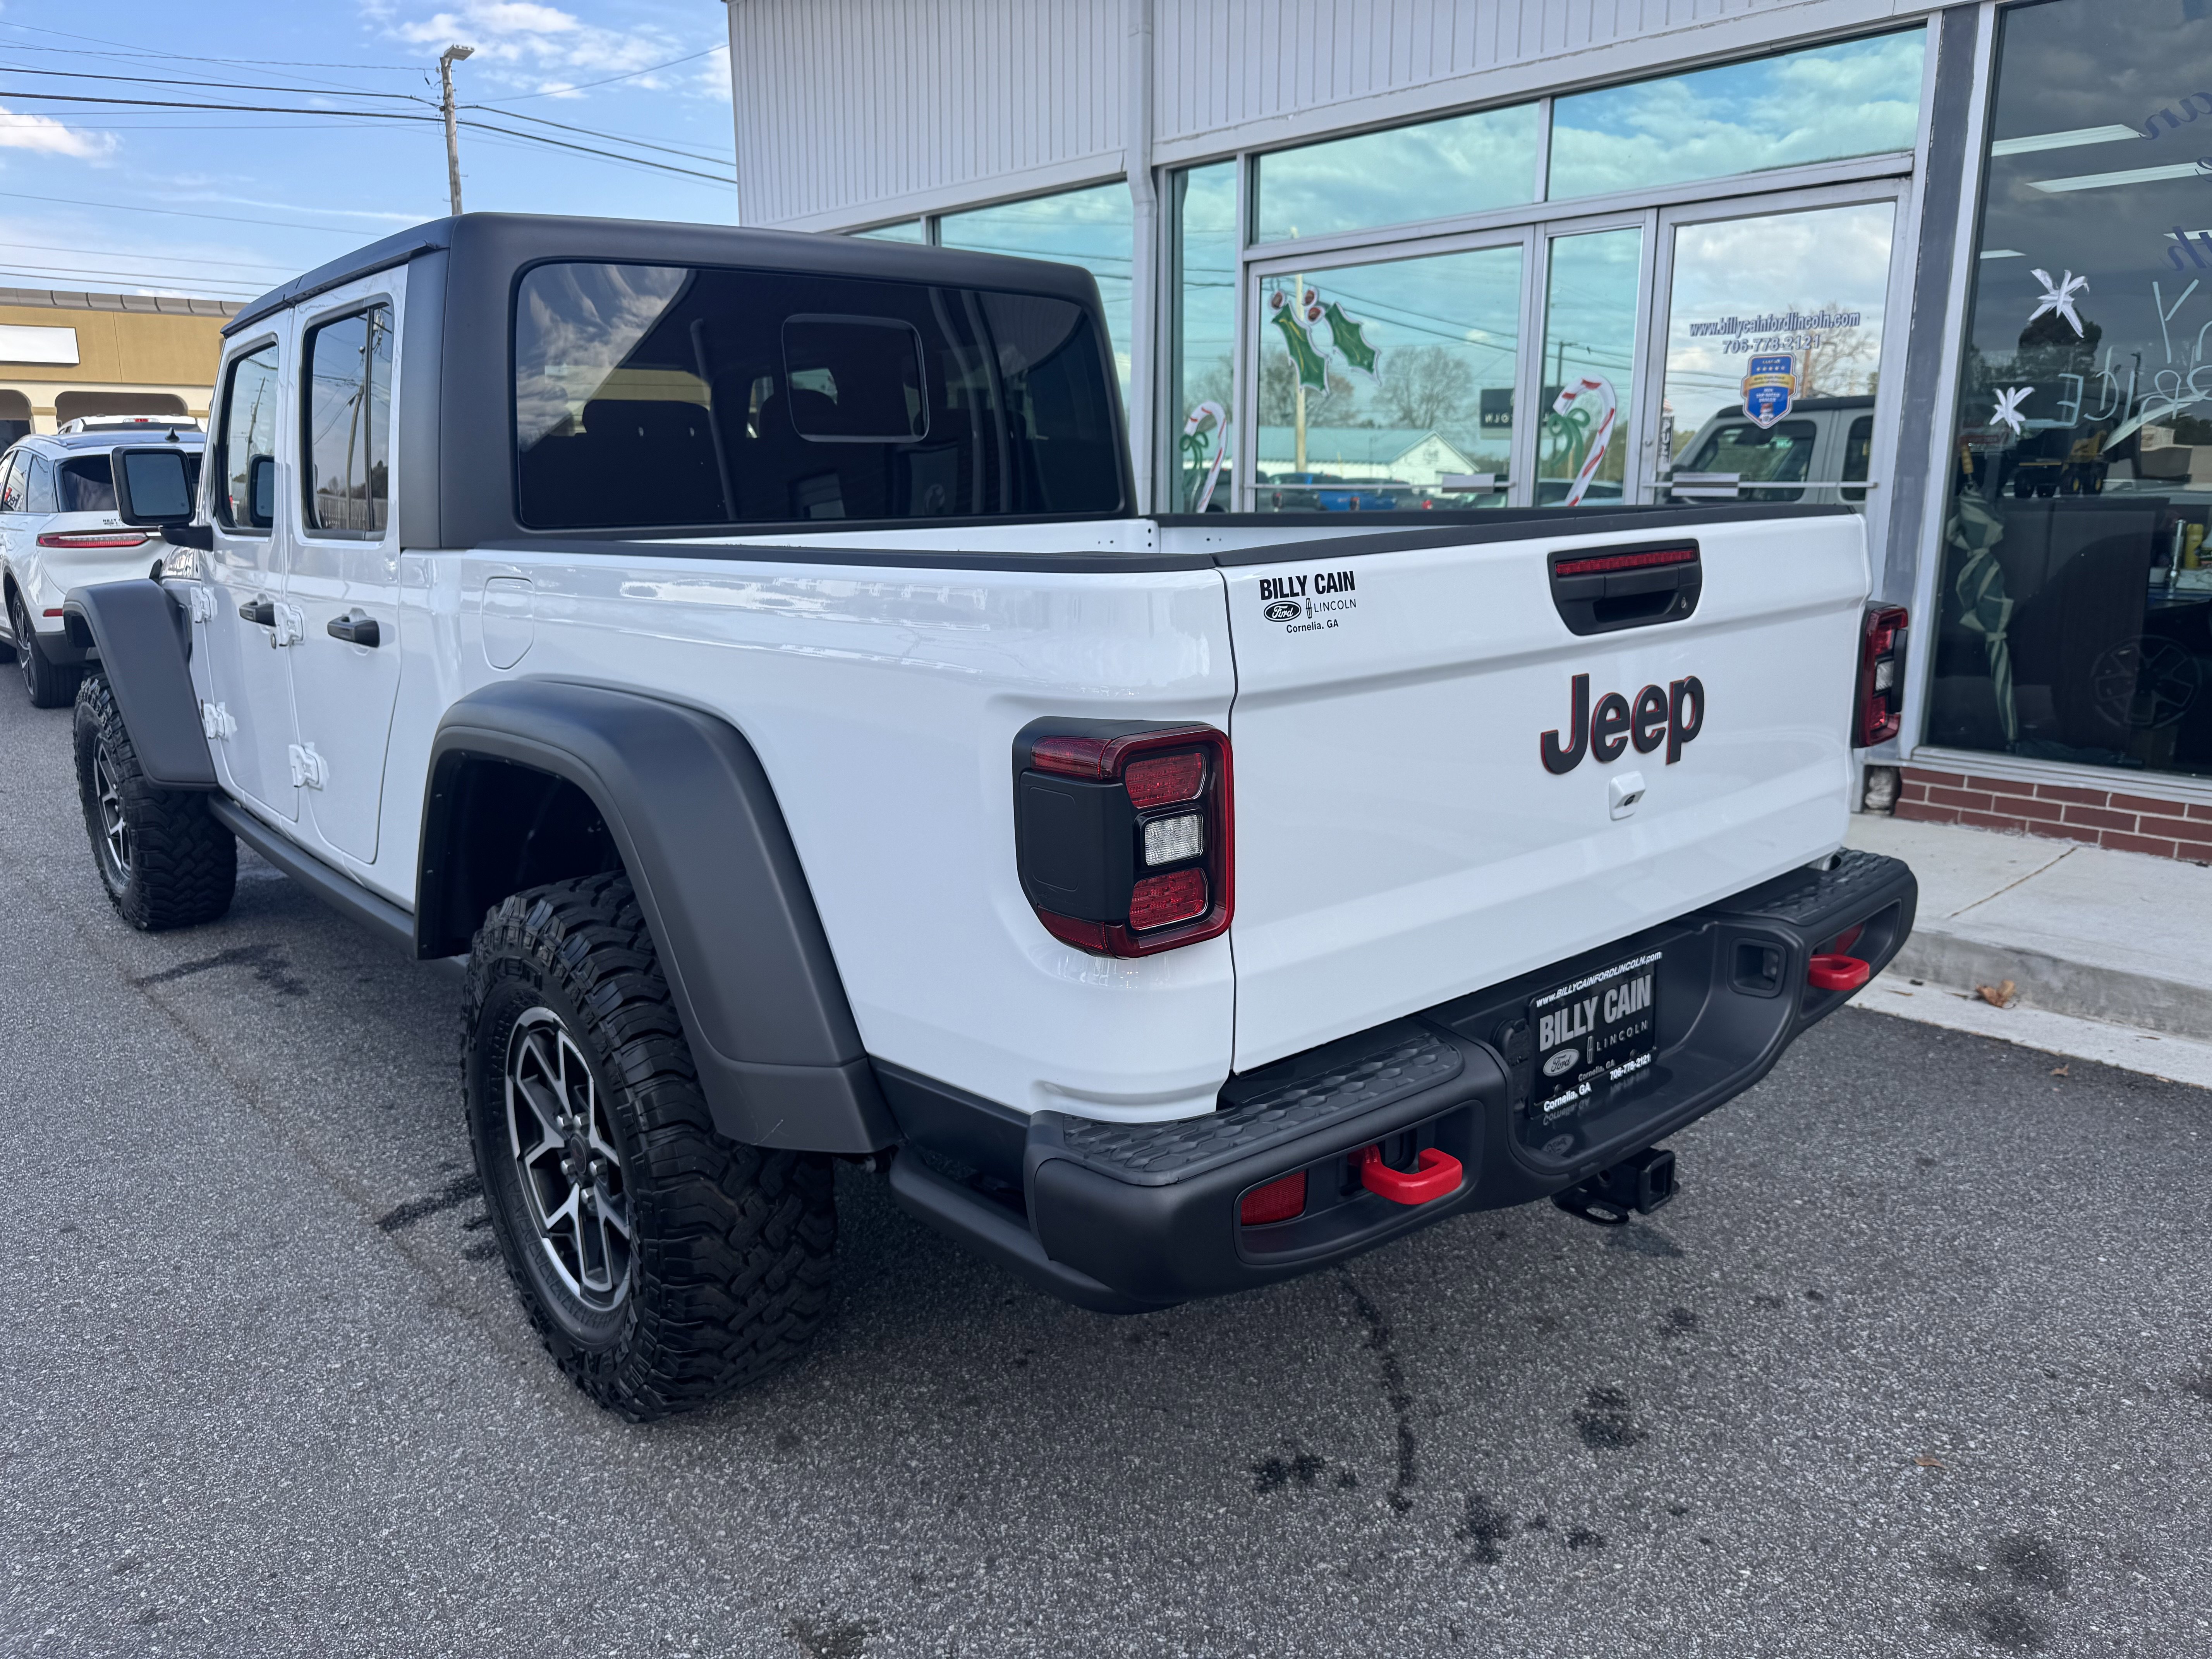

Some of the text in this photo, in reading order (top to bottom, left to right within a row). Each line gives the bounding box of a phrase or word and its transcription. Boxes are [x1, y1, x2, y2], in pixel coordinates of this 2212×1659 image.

[1689, 310, 1860, 338] www.billycainfordlincoln.com
[1722, 335, 1820, 354] 706-778-2121
[1259, 571, 1355, 600] BILLY CAIN
[1314, 599, 1356, 612] LINCOLN
[1327, 619, 1339, 628] GA
[1540, 673, 1704, 775] Jeep
[1536, 951, 1662, 1008] www.BILLYCAINFORDLINCOLN.com
[1540, 974, 1651, 1052] BILLY CAIN
[1596, 1020, 1649, 1051] LINCOLN
[1606, 1059, 1615, 1069] GA
[1544, 1090, 1579, 1112] Cornelia,
[1579, 1082, 1592, 1096] GA
